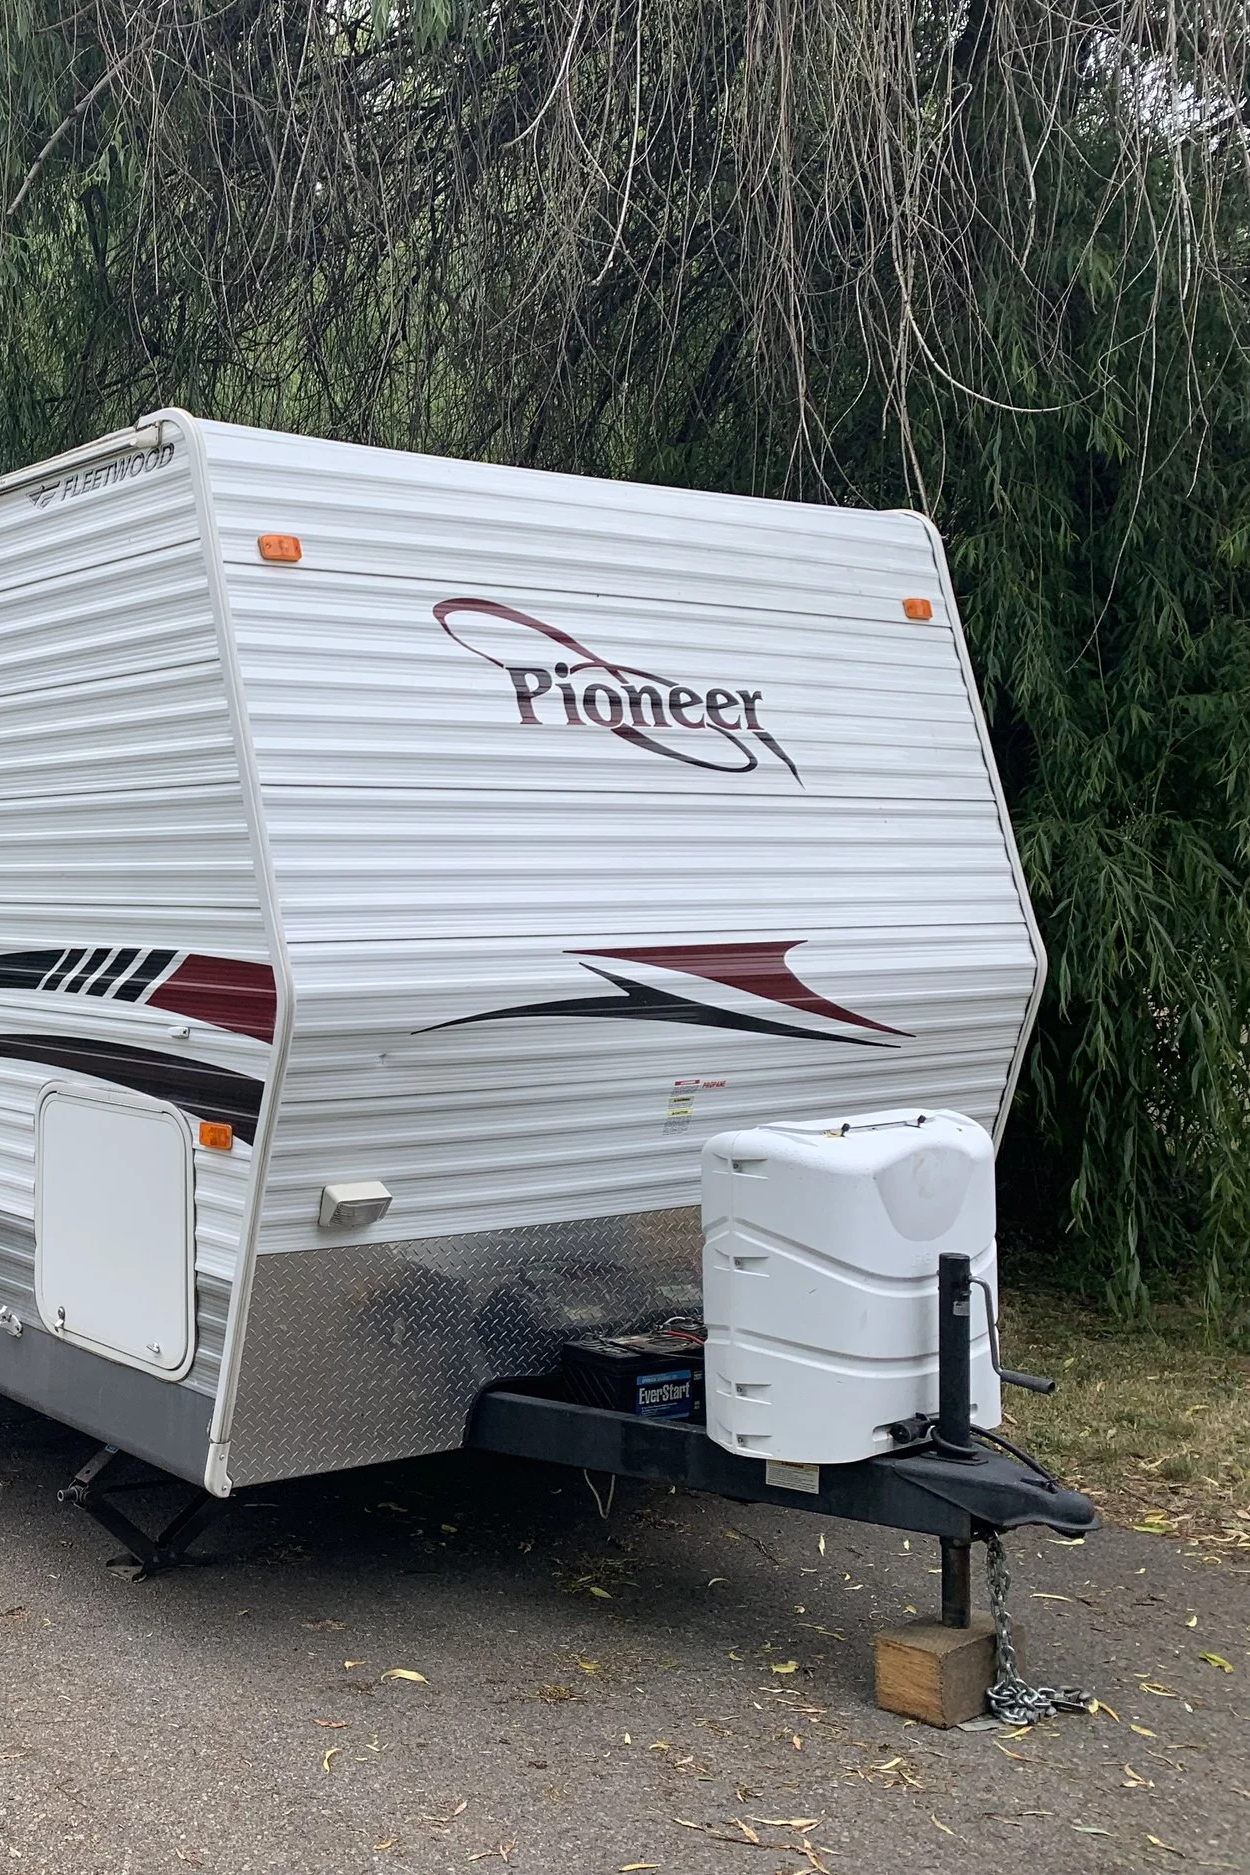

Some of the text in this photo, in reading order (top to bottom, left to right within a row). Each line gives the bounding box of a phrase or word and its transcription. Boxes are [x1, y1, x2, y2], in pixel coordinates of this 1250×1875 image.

[60, 442, 176, 501] FLEETWOOD
[505, 661, 765, 731] Pioneer
[701, 1080, 727, 1089] PROPANE
[638, 1381, 690, 1405] EverStart
